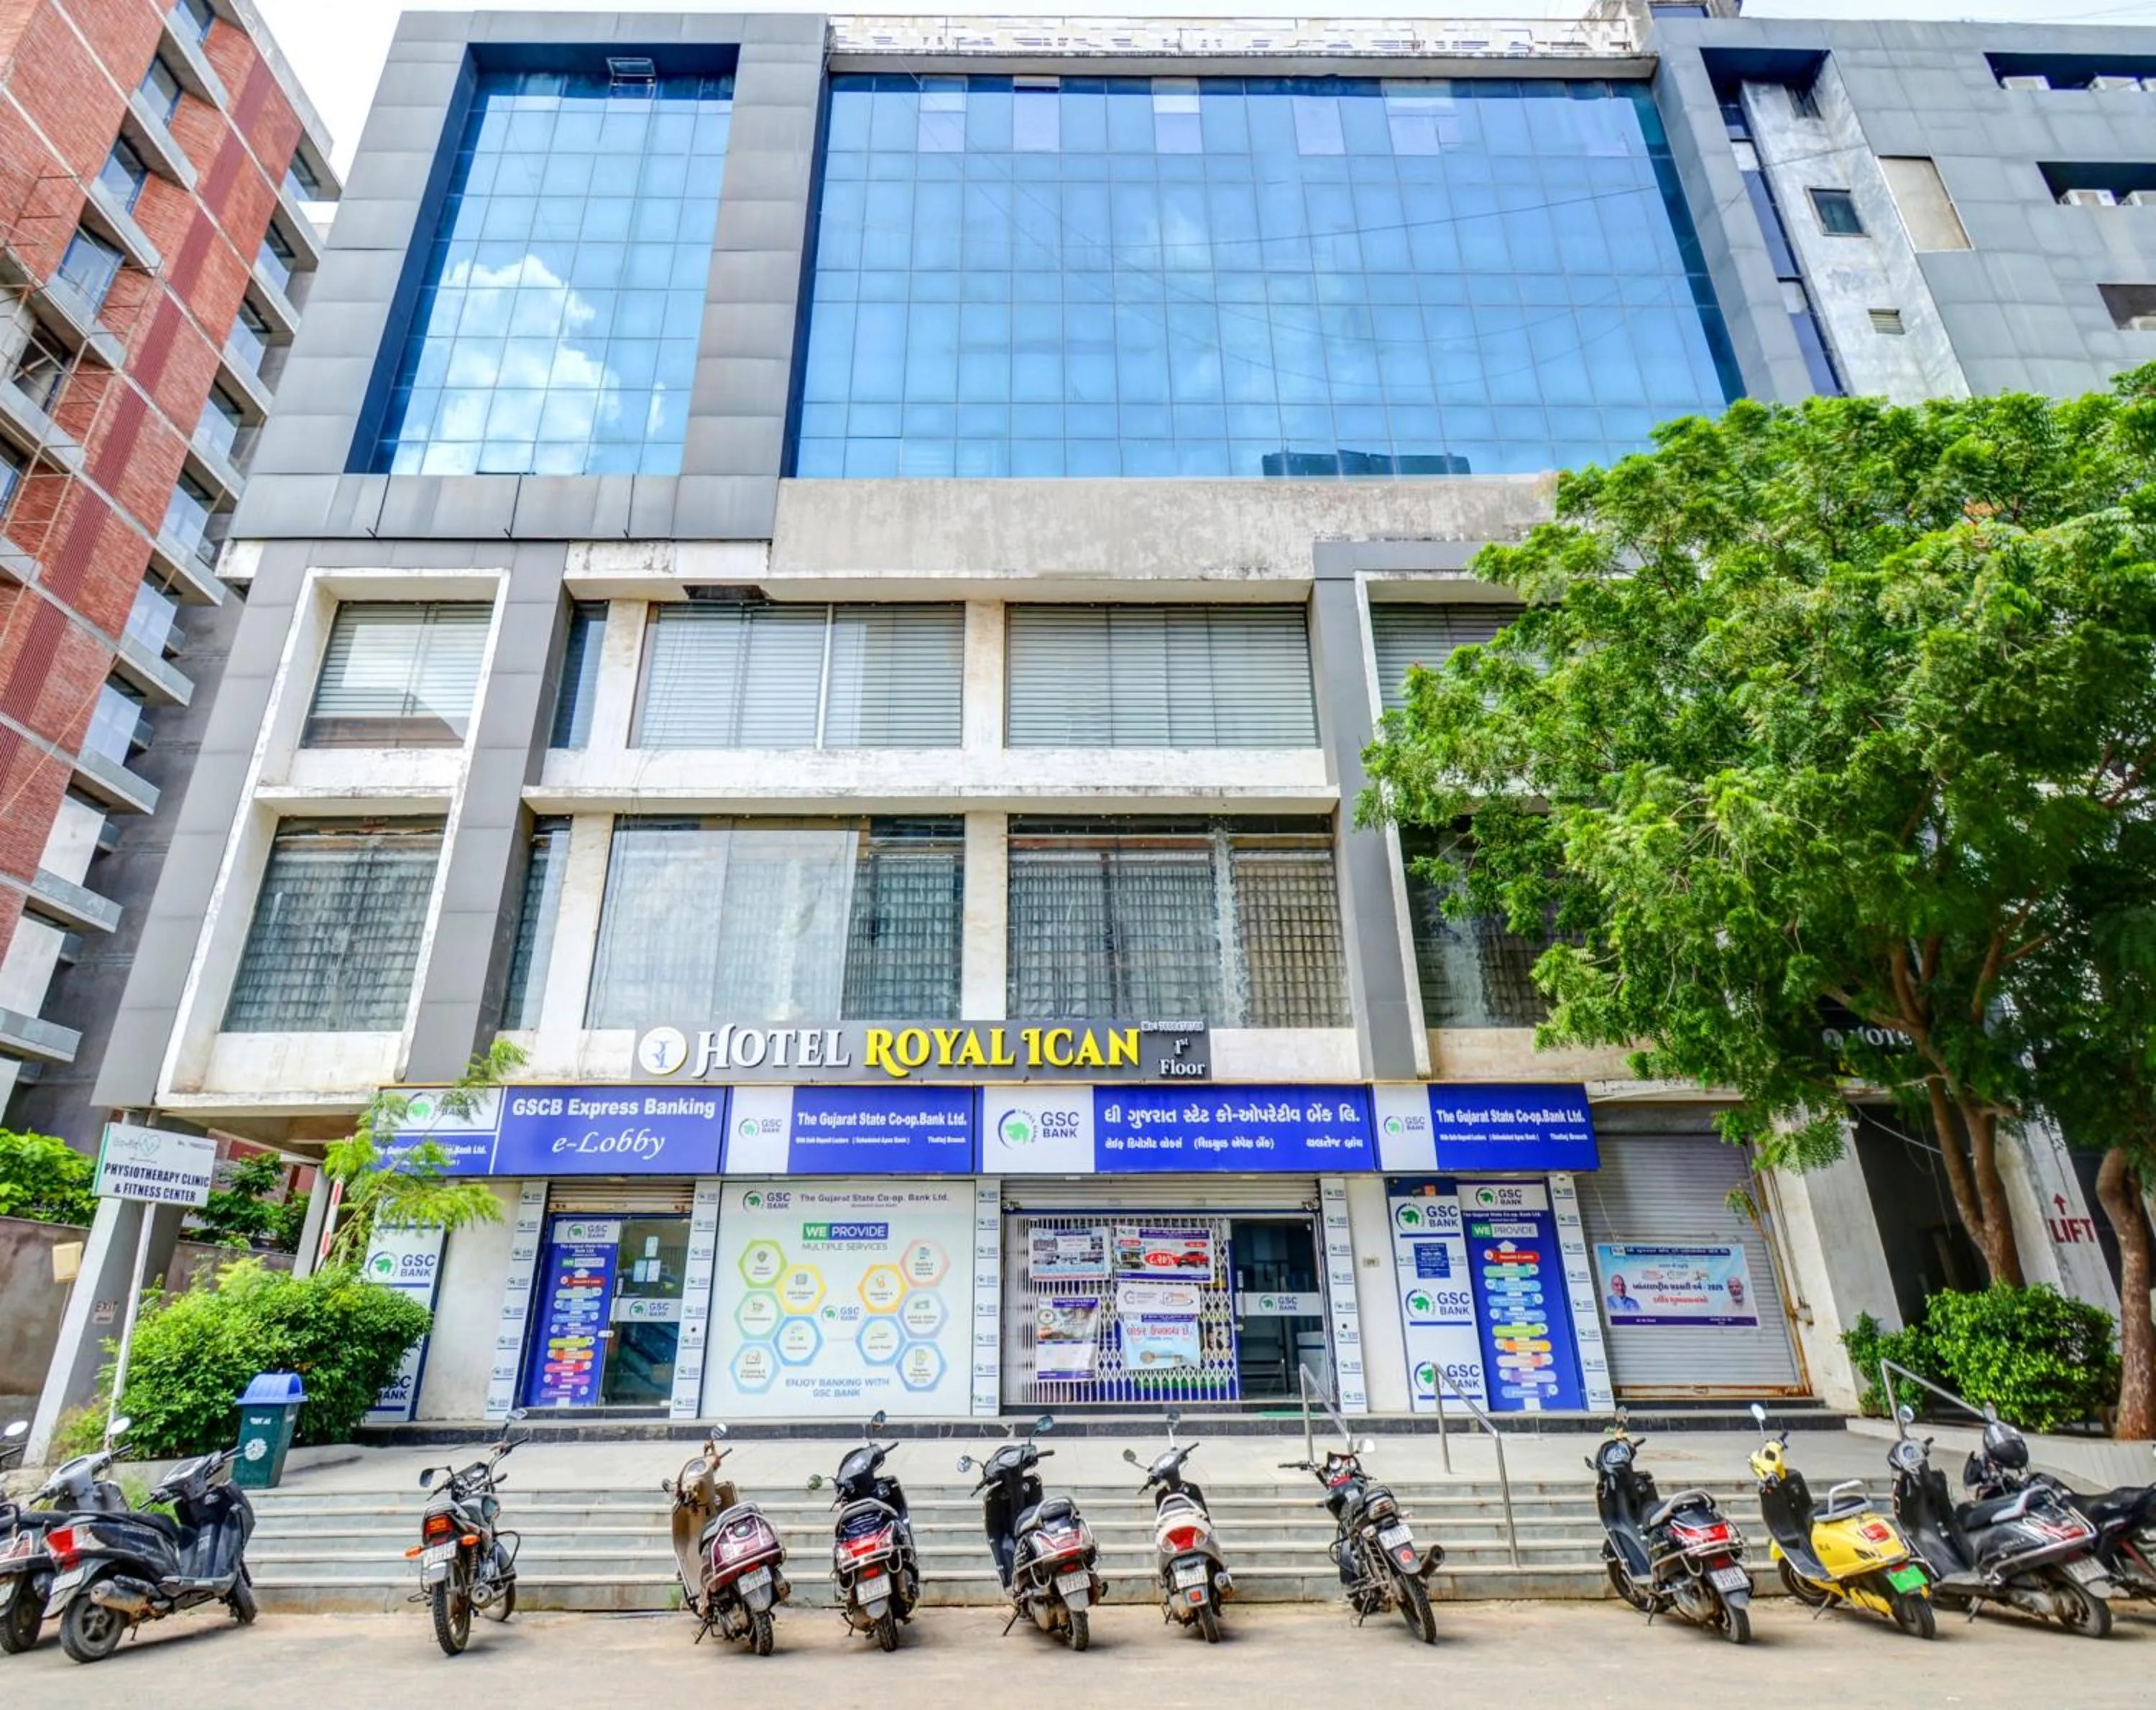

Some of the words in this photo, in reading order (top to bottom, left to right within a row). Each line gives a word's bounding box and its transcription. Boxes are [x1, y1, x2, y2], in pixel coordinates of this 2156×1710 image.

[691, 1023, 850, 1077] HOTEL
[863, 1027, 1015, 1077] ROYAL
[1174, 1037, 1189, 1054] 1st
[1161, 1059, 1205, 1075] Floor
[512, 1098, 563, 1116] GSCB
[568, 1098, 639, 1119] Express
[644, 1098, 716, 1119] Banking
[761, 1119, 782, 1127] GSC
[797, 1112, 817, 1126] The
[819, 1112, 857, 1129] Gujarat
[859, 1112, 886, 1126] State
[948, 1112, 967, 1126] Ltd.
[1041, 1112, 1079, 1127] GSC
[1127, 1109, 1176, 1129] ગુજરાત
[1183, 1104, 1210, 1123] સ્ટેટ
[1436, 1109, 1455, 1123] The
[1456, 1109, 1490, 1126] Gujarat
[1490, 1109, 1514, 1123] State
[1567, 1109, 1585, 1122] Ltd.
[1043, 1128, 1078, 1138] BANK
[552, 1128, 665, 1160] e-Lobby
[104, 1163, 180, 1183] PHYSIOTHERAPY
[181, 1173, 211, 1188] CLINIC
[114, 1183, 121, 1193] &
[124, 1183, 161, 1198] FITNESS
[163, 1188, 196, 1203] CENTER
[767, 1189, 791, 1202] GSC
[801, 1193, 816, 1202] The
[819, 1193, 850, 1203] Gujarat
[852, 1193, 875, 1202] State
[1498, 1189, 1523, 1198] GSC
[1427, 1205, 1458, 1218] GSC
[1429, 1219, 1459, 1228] BANK
[806, 1226, 827, 1237] WE
[831, 1226, 886, 1237] PROVIDE
[1474, 1226, 1491, 1235] WE
[1495, 1226, 1534, 1235] PROVIDE
[2048, 1218, 2094, 1243] LIFT
[402, 1254, 436, 1267] GSC
[400, 1268, 431, 1277] BANK
[1278, 1296, 1297, 1305] GSC
[1437, 1292, 1470, 1305] GSC
[649, 1302, 669, 1311] GSC
[840, 1306, 860, 1316] GSC
[1439, 1307, 1470, 1316] BANK
[1447, 1364, 1480, 1377] GSC
[786, 1379, 817, 1387] ENJOY
[813, 1389, 831, 1397] GSC
[834, 1388, 861, 1397] BANK
